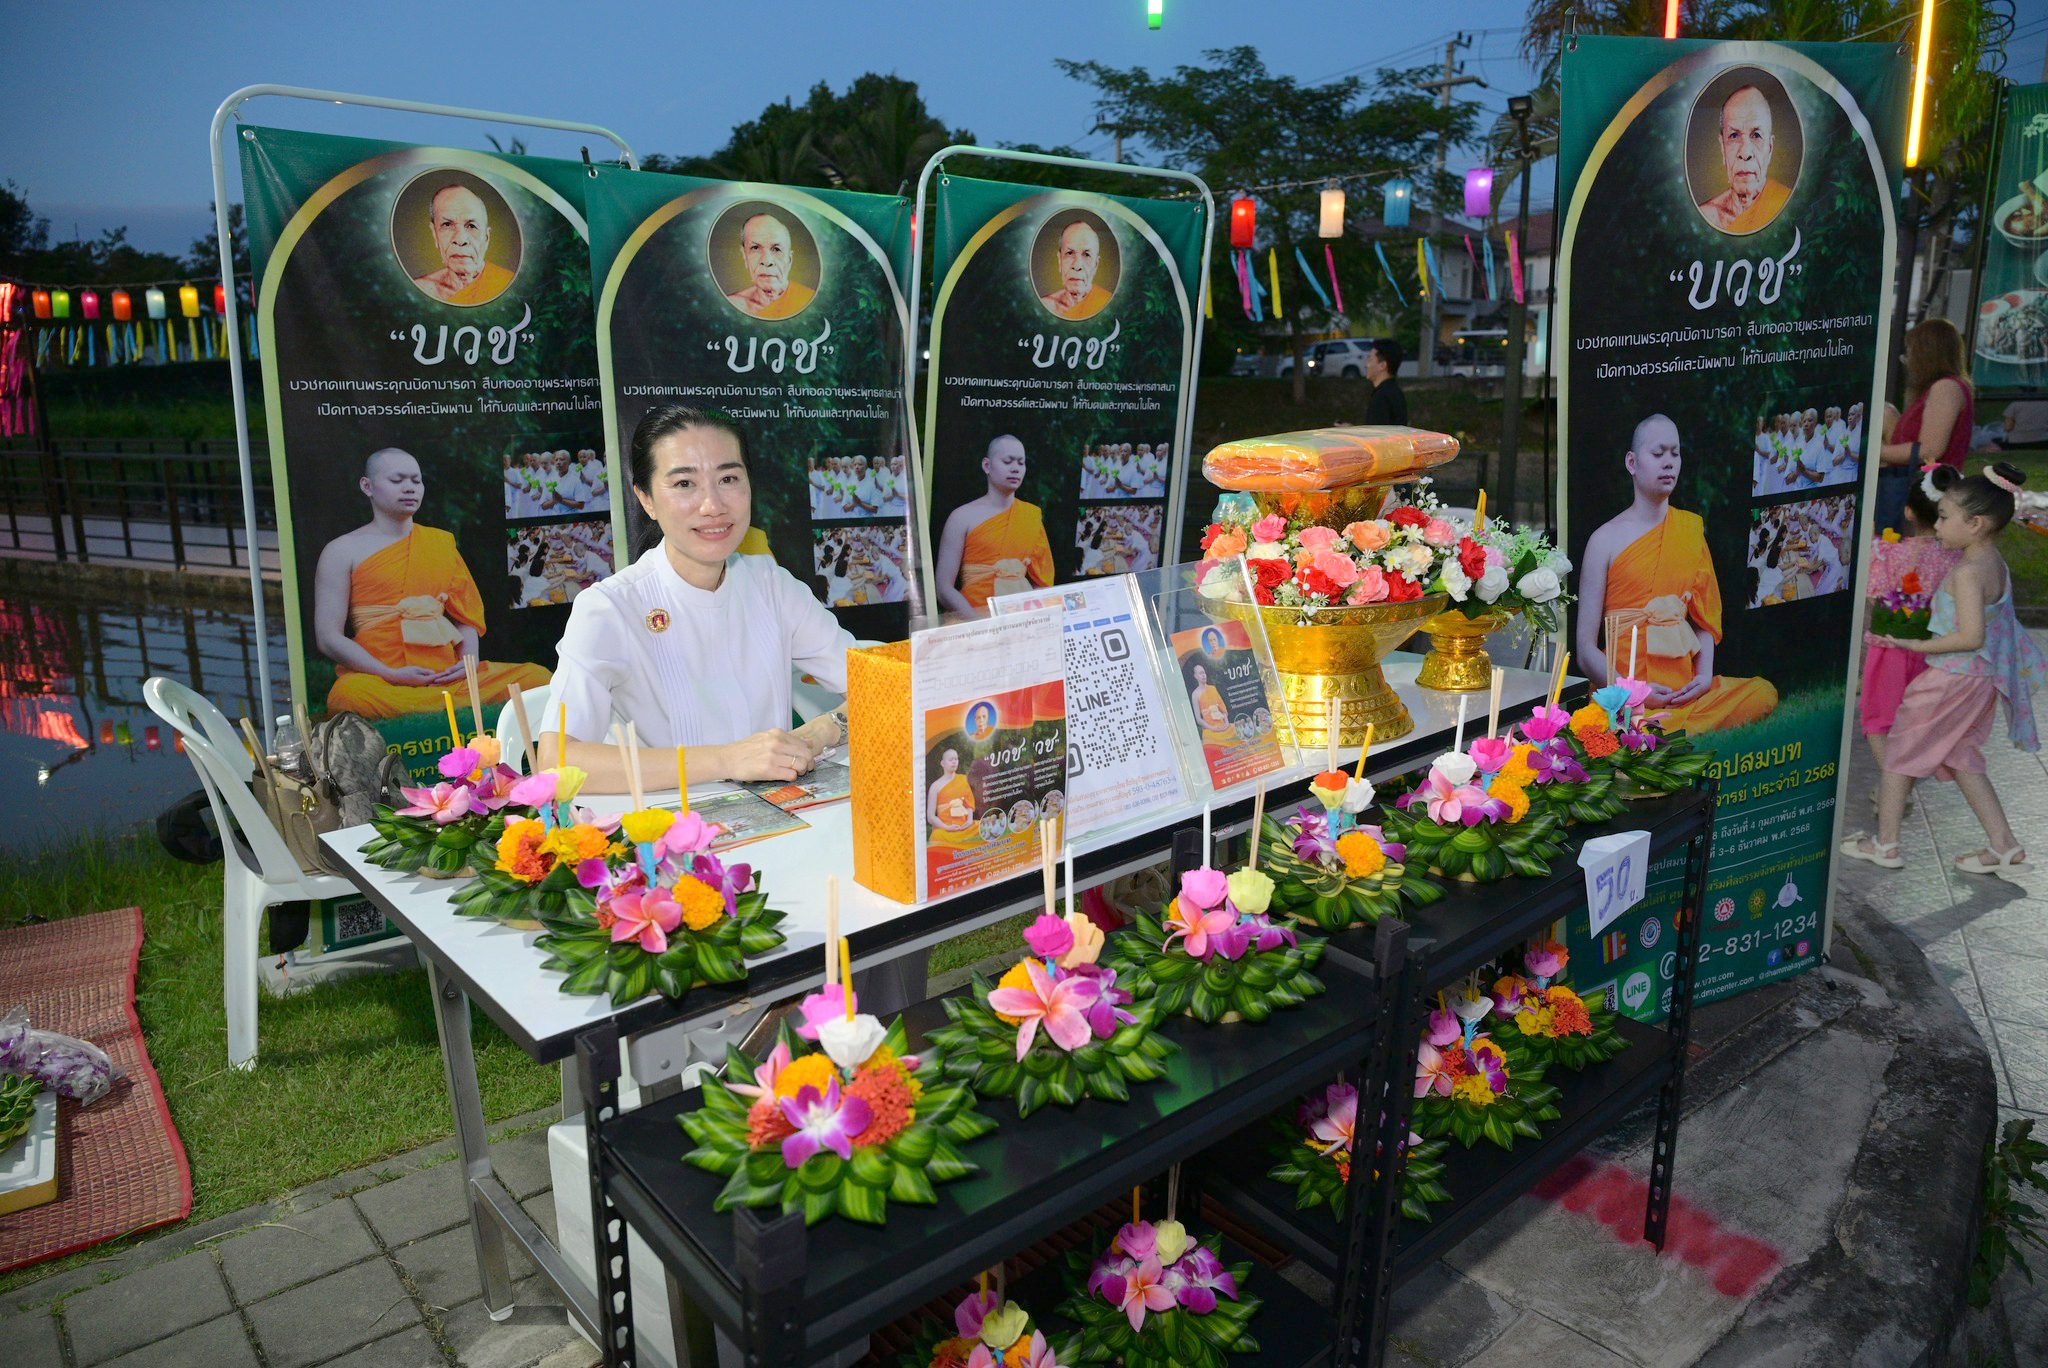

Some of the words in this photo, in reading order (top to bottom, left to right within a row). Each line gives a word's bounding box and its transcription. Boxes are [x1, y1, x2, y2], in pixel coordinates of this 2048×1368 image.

[1576, 322, 1742, 350] บวชทดแทนพระคุณบิดามารดา
[1747, 313, 1873, 339] สืบทอดอายุพระพุทธศาสนา
[1596, 356, 1735, 380] เปิดทางสวรรค์และนิพพาน
[1741, 338, 1854, 366] ให้กับตนและทุกคนในโลก
[290, 378, 476, 395] บวชทดแทนพระคุณบิดามารดา
[482, 375, 600, 391] สืบทอดอายุพระพุทธศา
[623, 384, 782, 399] บวชทดแทนพระคุณบิดามารดา
[945, 376, 1073, 391] บวชทดแทนพระคุณบิดามารดา
[1077, 378, 1175, 394] สืบทอดอายุพระพุทธศาสนา
[318, 399, 473, 416] เปิดทางสวรรค์และนิพพาน
[478, 395, 601, 415] ให้กับตนและทุกคนในโลก
[784, 403, 889, 421] ให้กับตนและทุกคนในโลก
[1076, 691, 1112, 713] LINE
[1752, 768, 1800, 798] ประจำปี
[1804, 762, 1836, 785] 2568
[1816, 797, 1835, 812] 2569
[1790, 822, 1811, 836] 2568
[1595, 854, 1632, 921] 50
[1697, 911, 1818, 964] 2-831-1234
[1626, 981, 1647, 999] LINE
